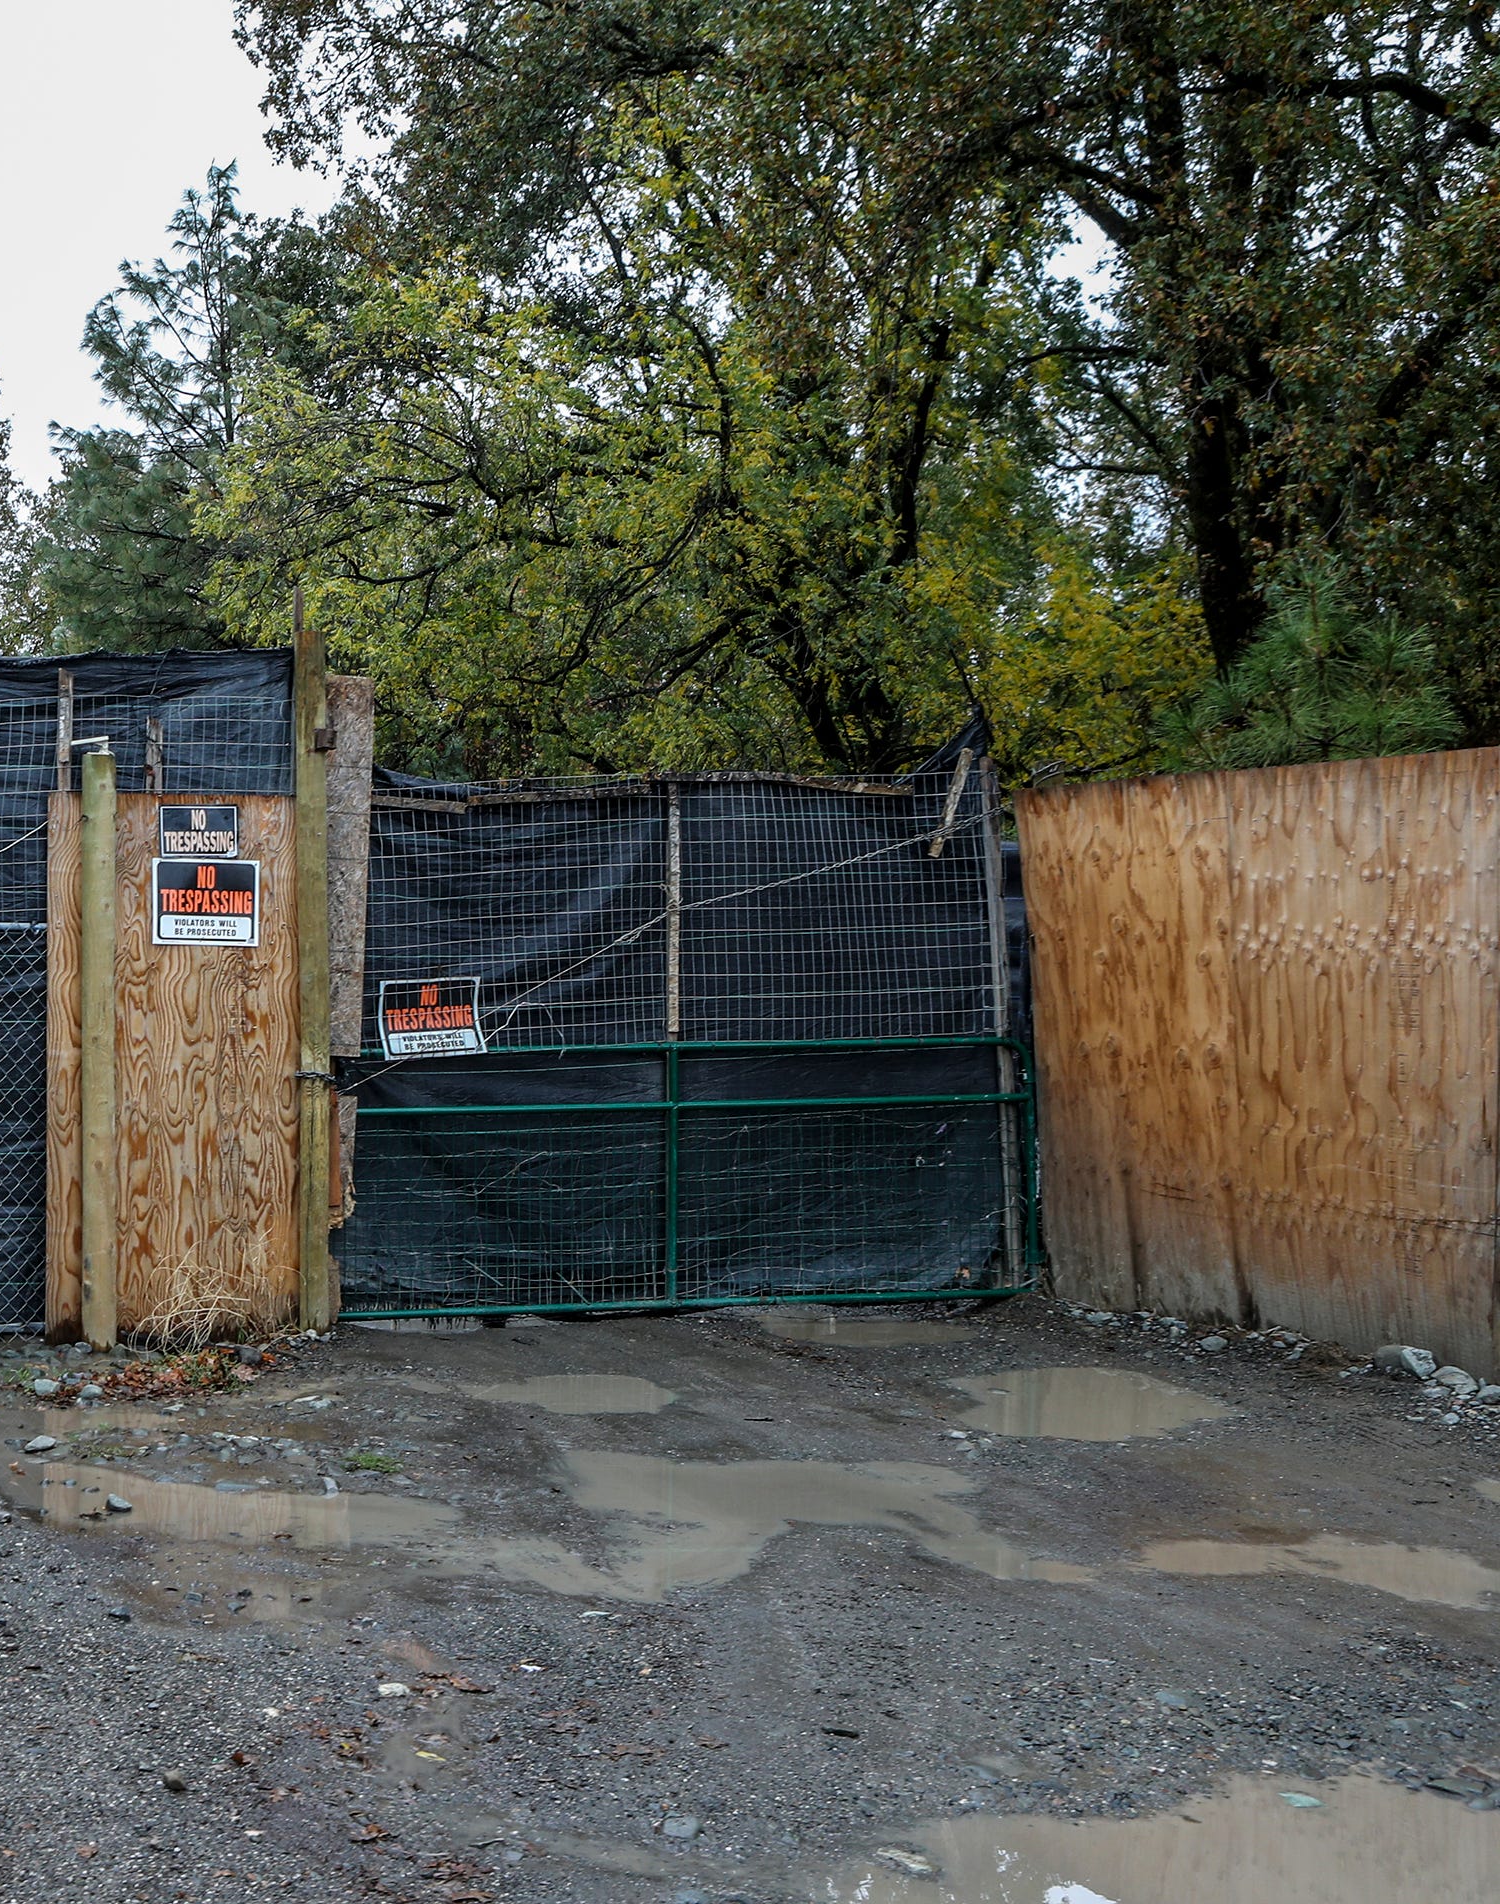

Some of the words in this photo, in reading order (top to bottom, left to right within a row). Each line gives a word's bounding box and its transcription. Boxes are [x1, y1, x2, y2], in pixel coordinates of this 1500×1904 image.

[190, 809, 206, 831] NO
[163, 831, 234, 852] TRESPASSING
[197, 865, 216, 889] NO
[160, 889, 253, 914] TRESPASSING
[174, 918, 215, 927] VIOLATORS
[186, 928, 237, 936] PROSECUTED
[420, 984, 438, 1006] NO
[385, 1004, 474, 1031] TRESPASSING
[404, 1043, 414, 1051] BE
[416, 1041, 465, 1051] PROSECUTED
